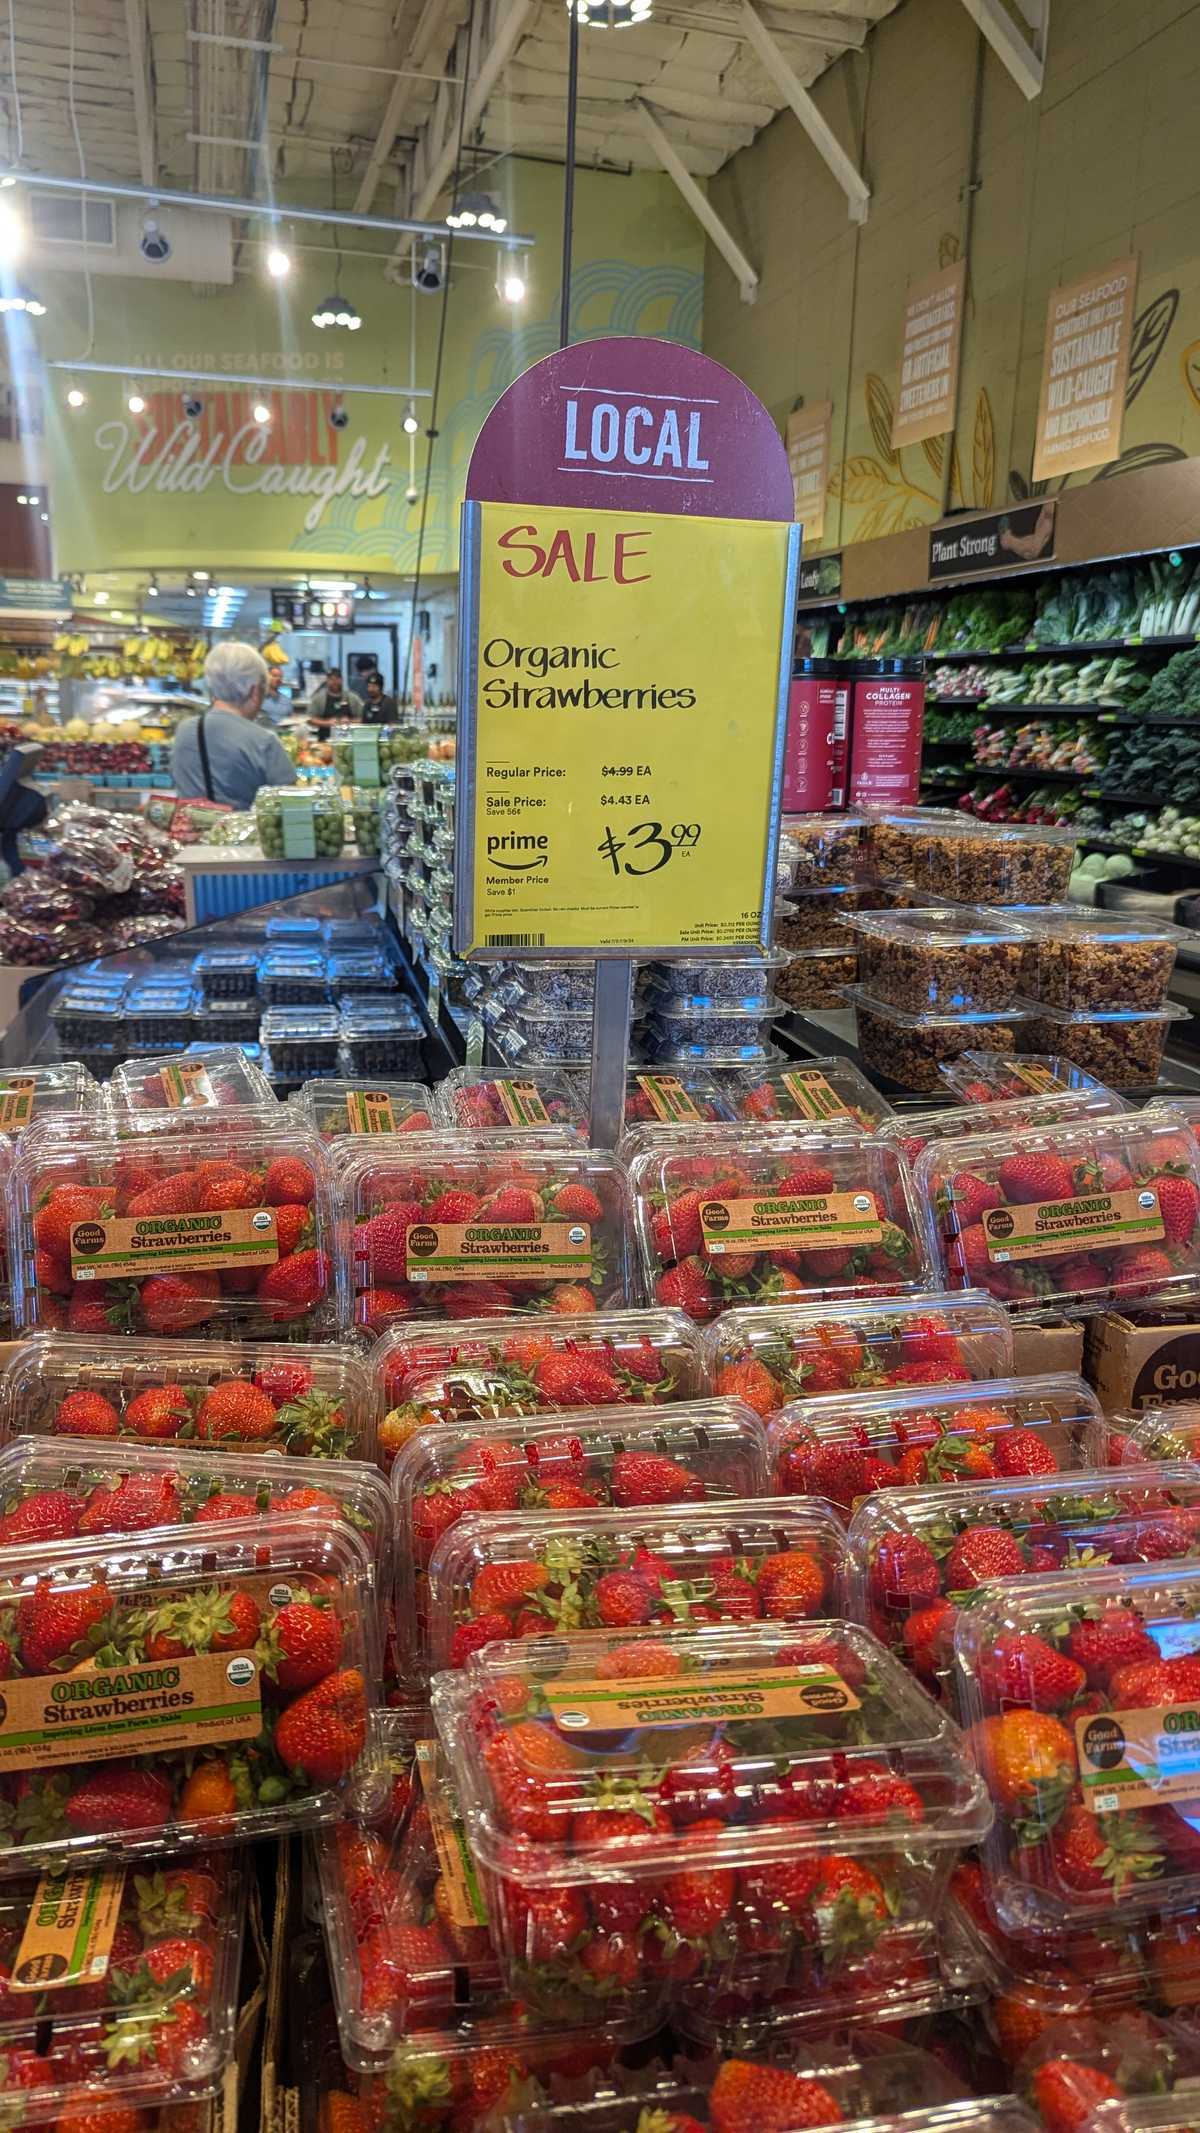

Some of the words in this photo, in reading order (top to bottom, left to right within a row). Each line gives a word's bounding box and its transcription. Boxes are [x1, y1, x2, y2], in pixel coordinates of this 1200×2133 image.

[1077, 276, 1129, 311] SEAFOOD
[174, 352, 217, 370] OUR
[222, 352, 320, 370] SEAFOOD
[324, 352, 345, 370] IS
[1047, 359, 1118, 411] WILD-CAUGHT
[564, 400, 710, 470] LOCAL
[95, 421, 224, 494] Wild
[222, 420, 392, 532] Caught
[497, 525, 653, 585] SALE
[931, 540, 958, 564] Plant
[959, 533, 998, 557] Strong
[483, 638, 621, 678] Organic
[483, 678, 697, 710] Strawberries
[865, 692, 912, 700] COLLAGEN
[486, 766, 531, 780] Regular
[533, 766, 566, 778] Price:
[601, 765, 634, 778] $4.99
[636, 765, 652, 777] EA
[486, 796, 512, 808] Sale
[513, 796, 546, 808] Price:
[600, 795, 633, 807] $4.43
[635, 795, 650, 806] EA
[486, 807, 506, 817] Save
[487, 831, 549, 855] prime
[681, 850, 691, 858] EA
[486, 875, 525, 886] Member
[526, 875, 549, 885] Price
[486, 888, 506, 898] Save
[507, 887, 516, 897] $1
[750, 911, 763, 919] OZ
[753, 1198, 828, 1215] ORGANIC
[1038, 1197, 1112, 1220] ORGANIC
[136, 1215, 223, 1235] ORGANIC
[751, 1211, 838, 1227] Strawberries
[1035, 1210, 1122, 1232] Strawberries
[75, 1236, 105, 1246] Farms
[77, 1229, 101, 1238] Good
[130, 1230, 232, 1249] Strawberries
[413, 1232, 434, 1240] Good
[465, 1227, 542, 1241] ORGANIC
[410, 1240, 437, 1248] Farms
[460, 1241, 549, 1255] Strawberries
[1153, 1363, 1200, 1391] Go
[51, 1667, 181, 1703] ORGANIC
[44, 1690, 194, 1725] Strawberries
[616, 1691, 766, 1712] Strawberries
[636, 1702, 765, 1723] ORGANIC
[42, 1727, 83, 1740] Improving
[1088, 1727, 1118, 1741] Good
